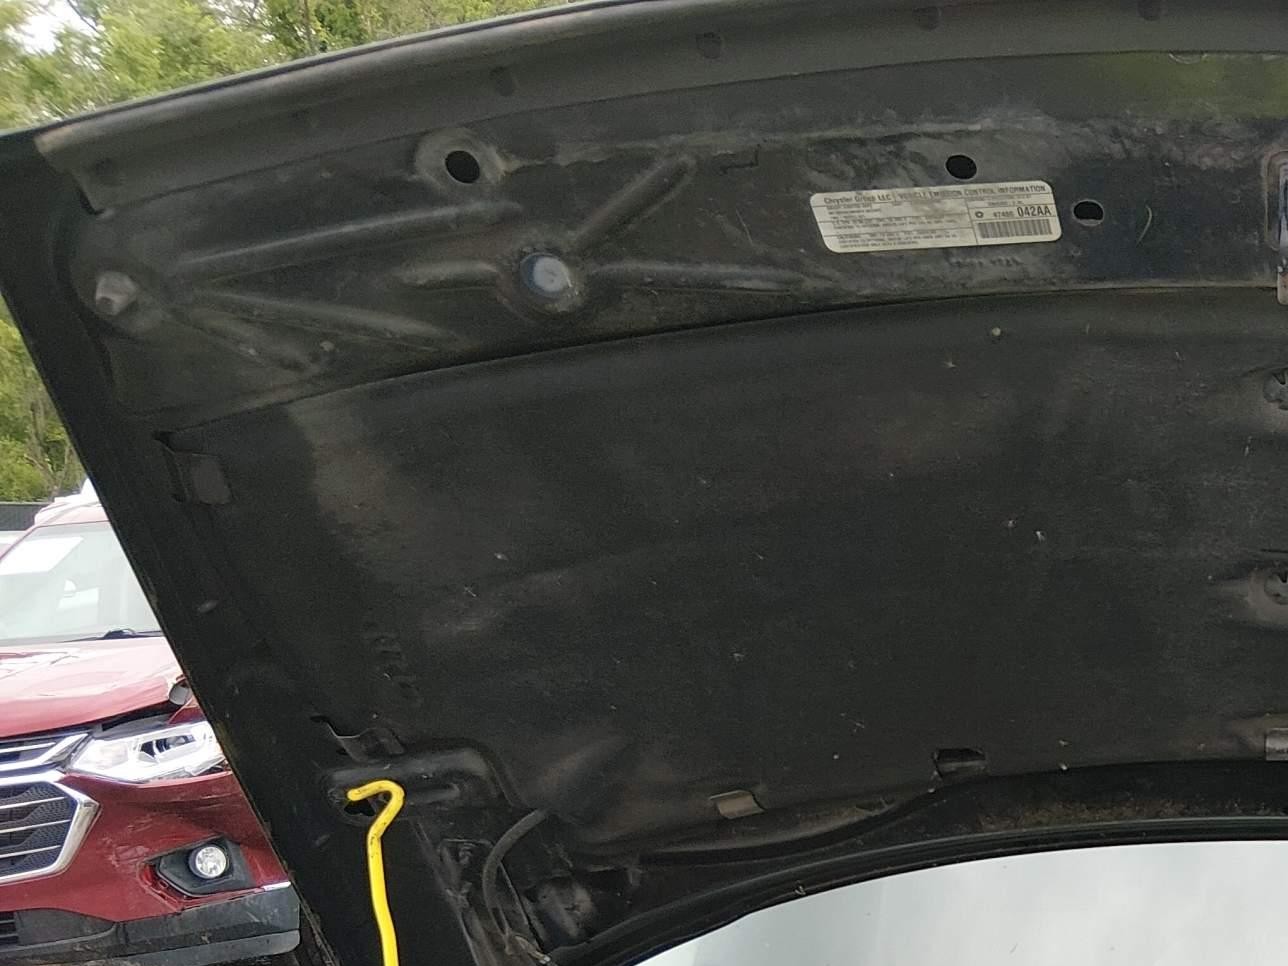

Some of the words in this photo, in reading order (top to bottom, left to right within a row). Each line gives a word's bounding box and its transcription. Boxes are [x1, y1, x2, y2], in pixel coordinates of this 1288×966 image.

[877, 193, 892, 201] LLC
[998, 184, 1046, 194] INFORMATION
[1016, 205, 1052, 217] 042AA
